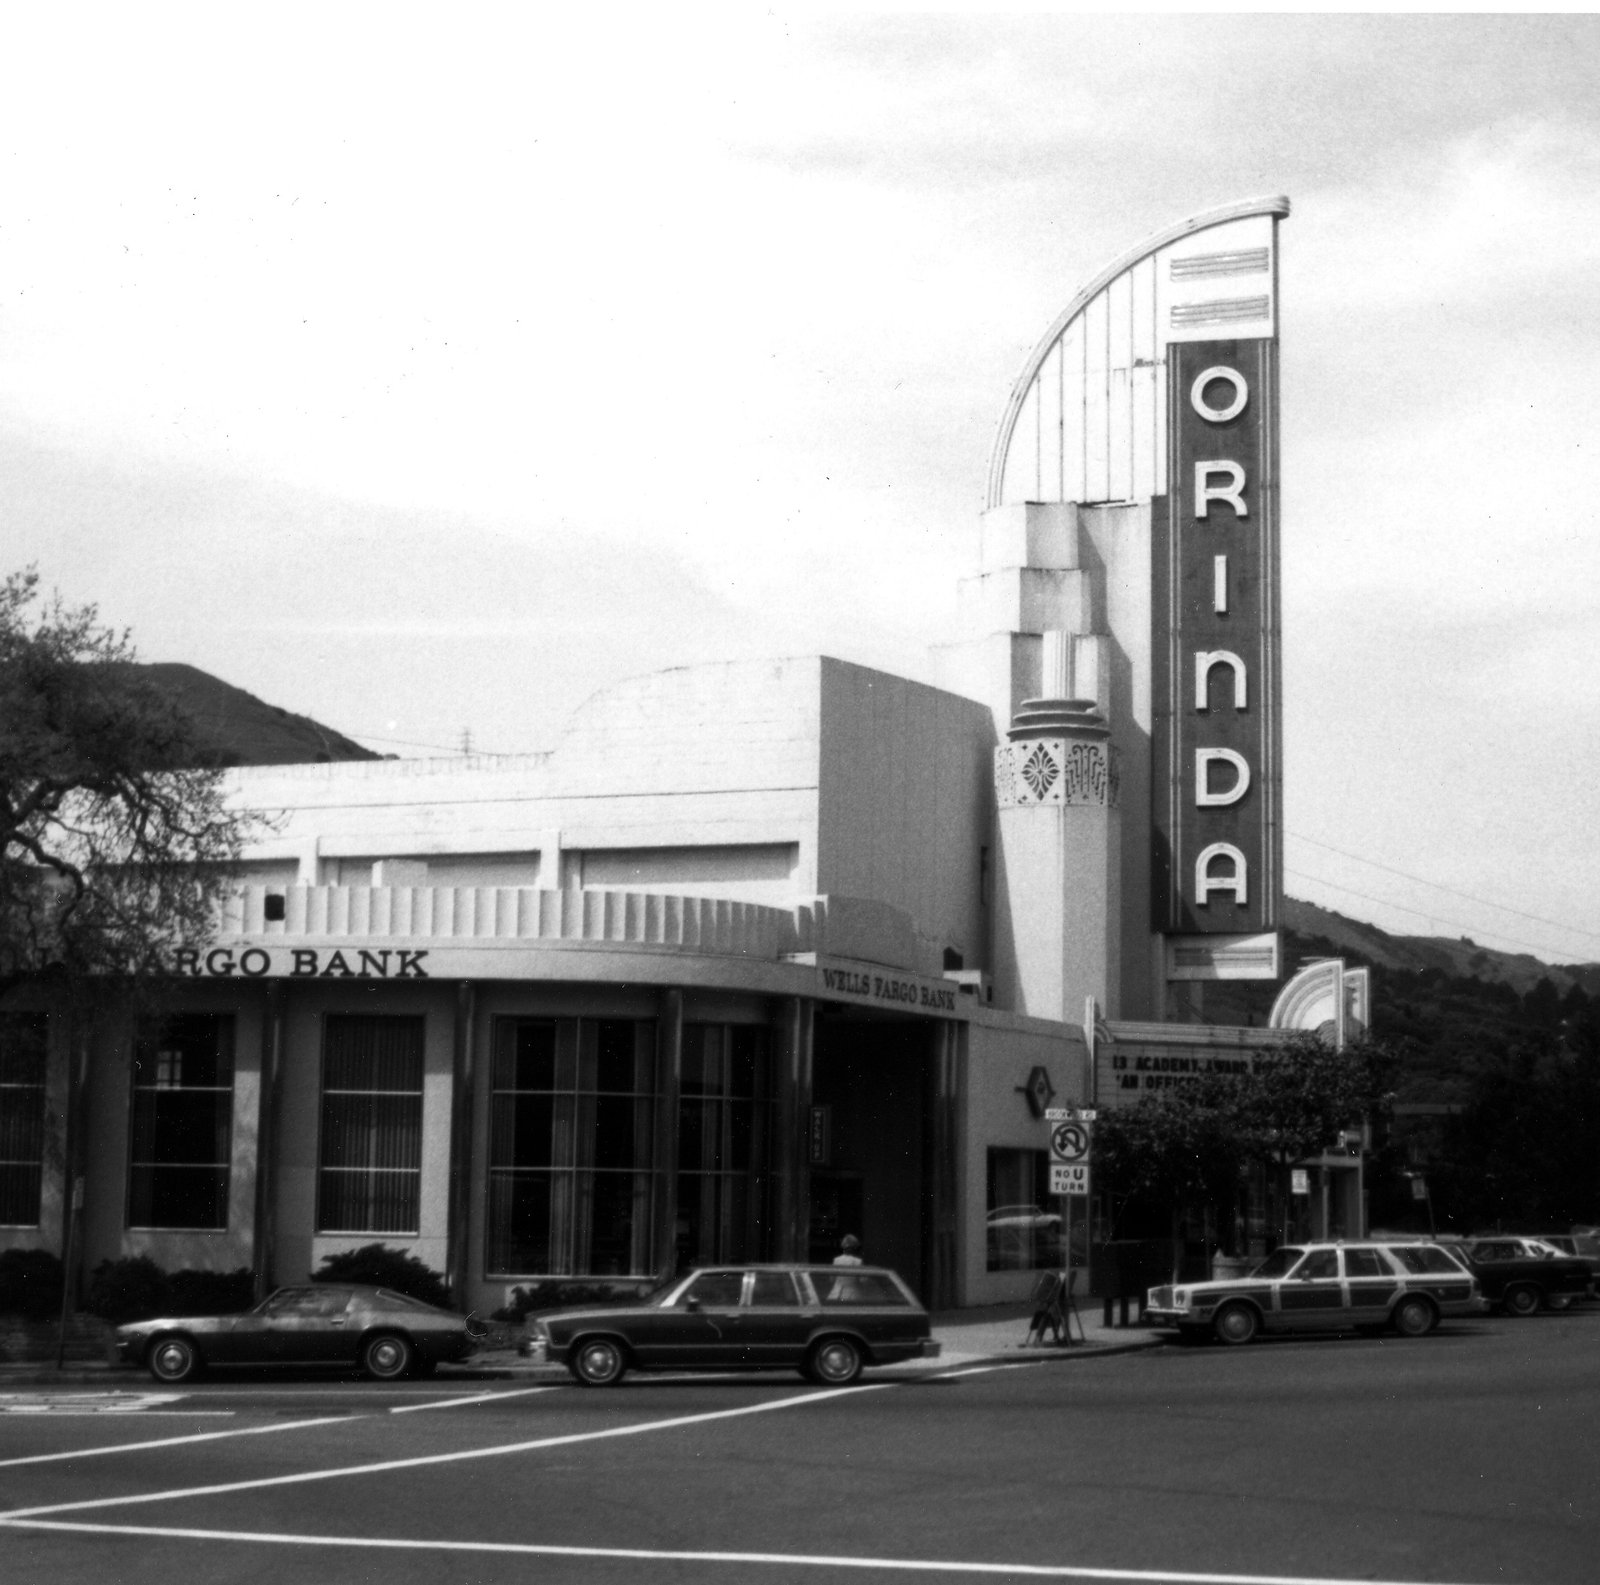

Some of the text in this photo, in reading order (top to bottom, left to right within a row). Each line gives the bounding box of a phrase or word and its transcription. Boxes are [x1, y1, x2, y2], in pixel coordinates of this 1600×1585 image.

[1190, 365, 1250, 905] ORINDA
[289, 948, 429, 978] BANK
[822, 967, 955, 1011] WELLS FARGO BANK
[1113, 1055, 1127, 1070] 13
[1135, 1057, 1198, 1073] ACADEMY
[1056, 1167, 1083, 1180] NO U
[1055, 1182, 1084, 1191] TURN
